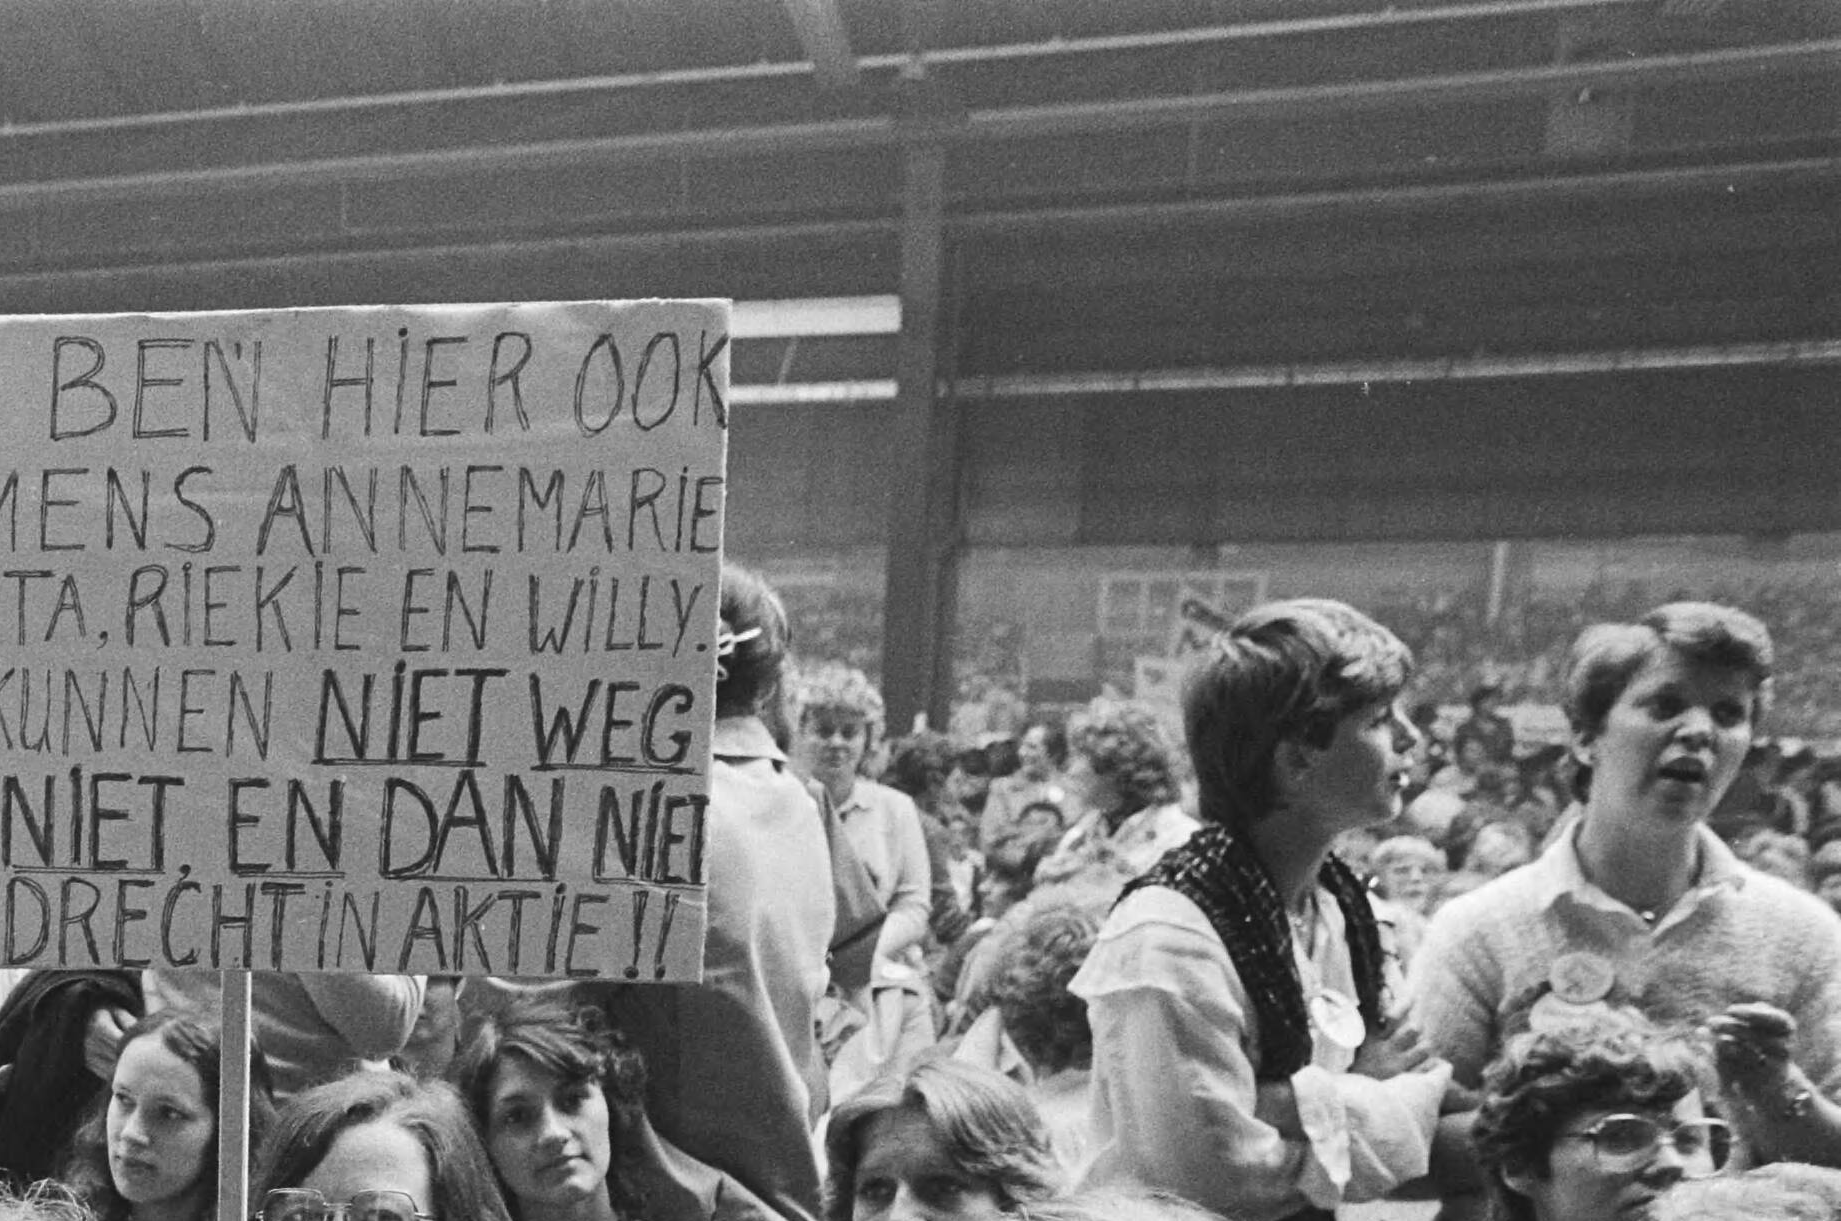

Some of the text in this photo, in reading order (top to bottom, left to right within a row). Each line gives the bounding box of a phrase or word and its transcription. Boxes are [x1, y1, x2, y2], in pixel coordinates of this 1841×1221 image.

[49, 335, 263, 444] BEN
[573, 329, 728, 438] OOK
[400, 566, 493, 653] EN
[529, 671, 696, 768] WEG
[227, 776, 348, 873] EN
[378, 769, 566, 880] DAN
